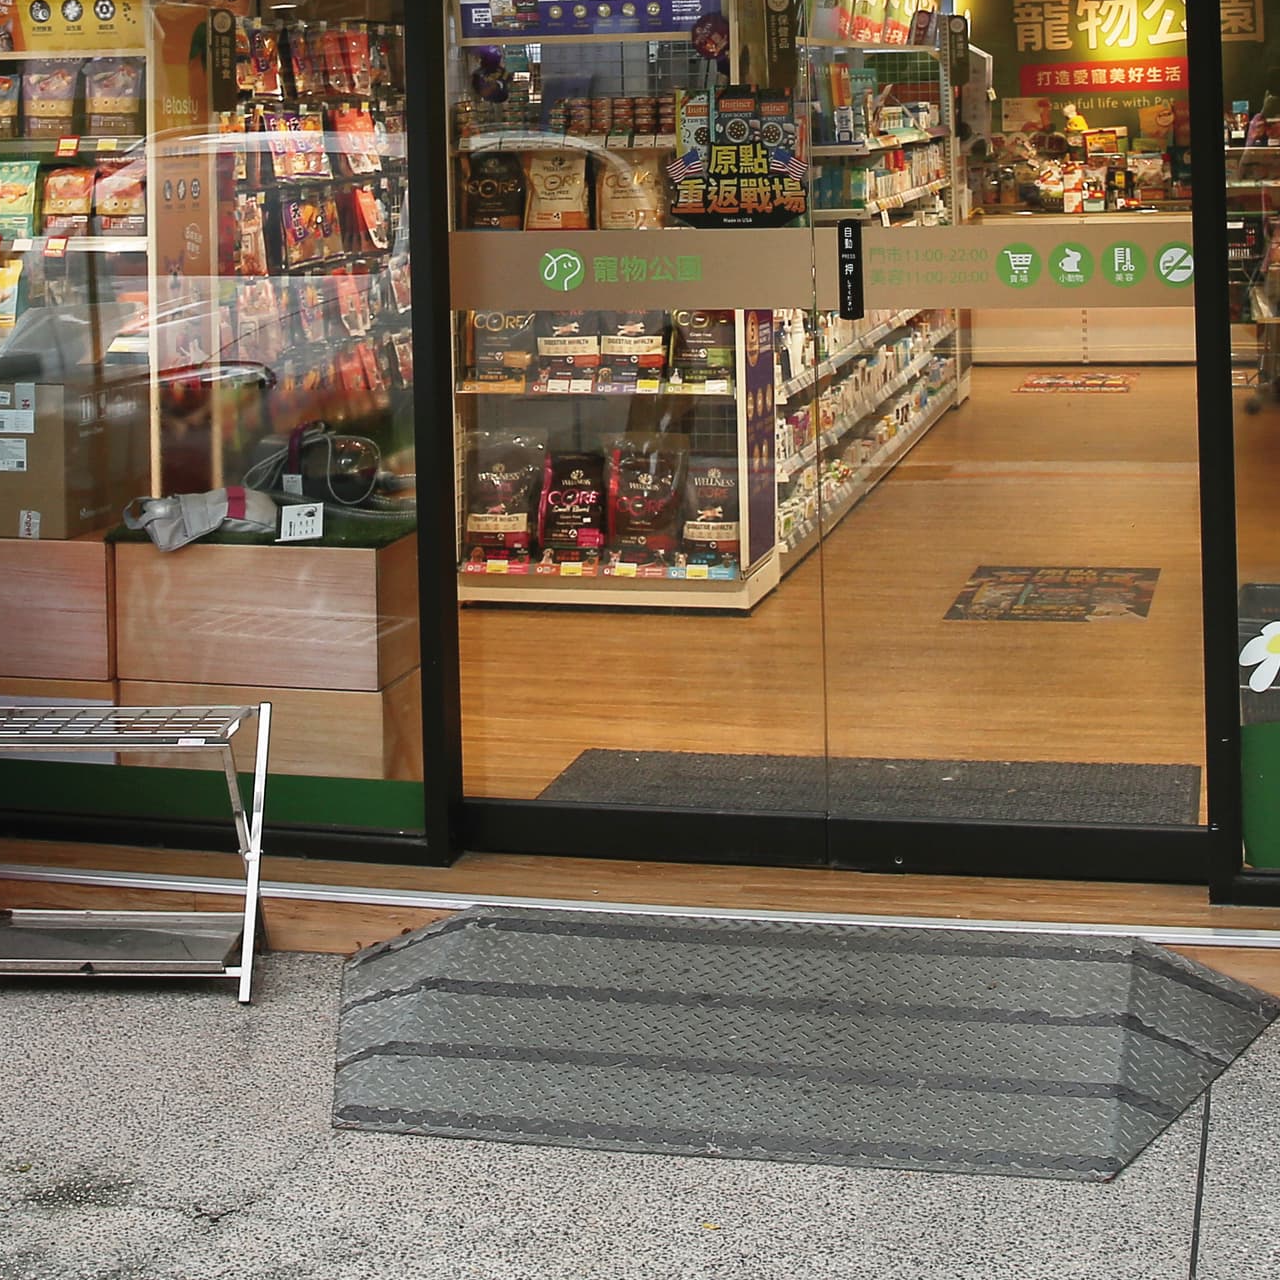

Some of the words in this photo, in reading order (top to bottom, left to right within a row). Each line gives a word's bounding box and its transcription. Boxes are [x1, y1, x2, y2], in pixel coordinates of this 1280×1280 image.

[1036, 66, 1182, 86] 打造愛寵美好生活
[1047, 96, 1093, 111] eautiful
[708, 143, 769, 176] 原點
[671, 178, 808, 216] 重返戰場
[593, 255, 703, 282] 寵物公園
